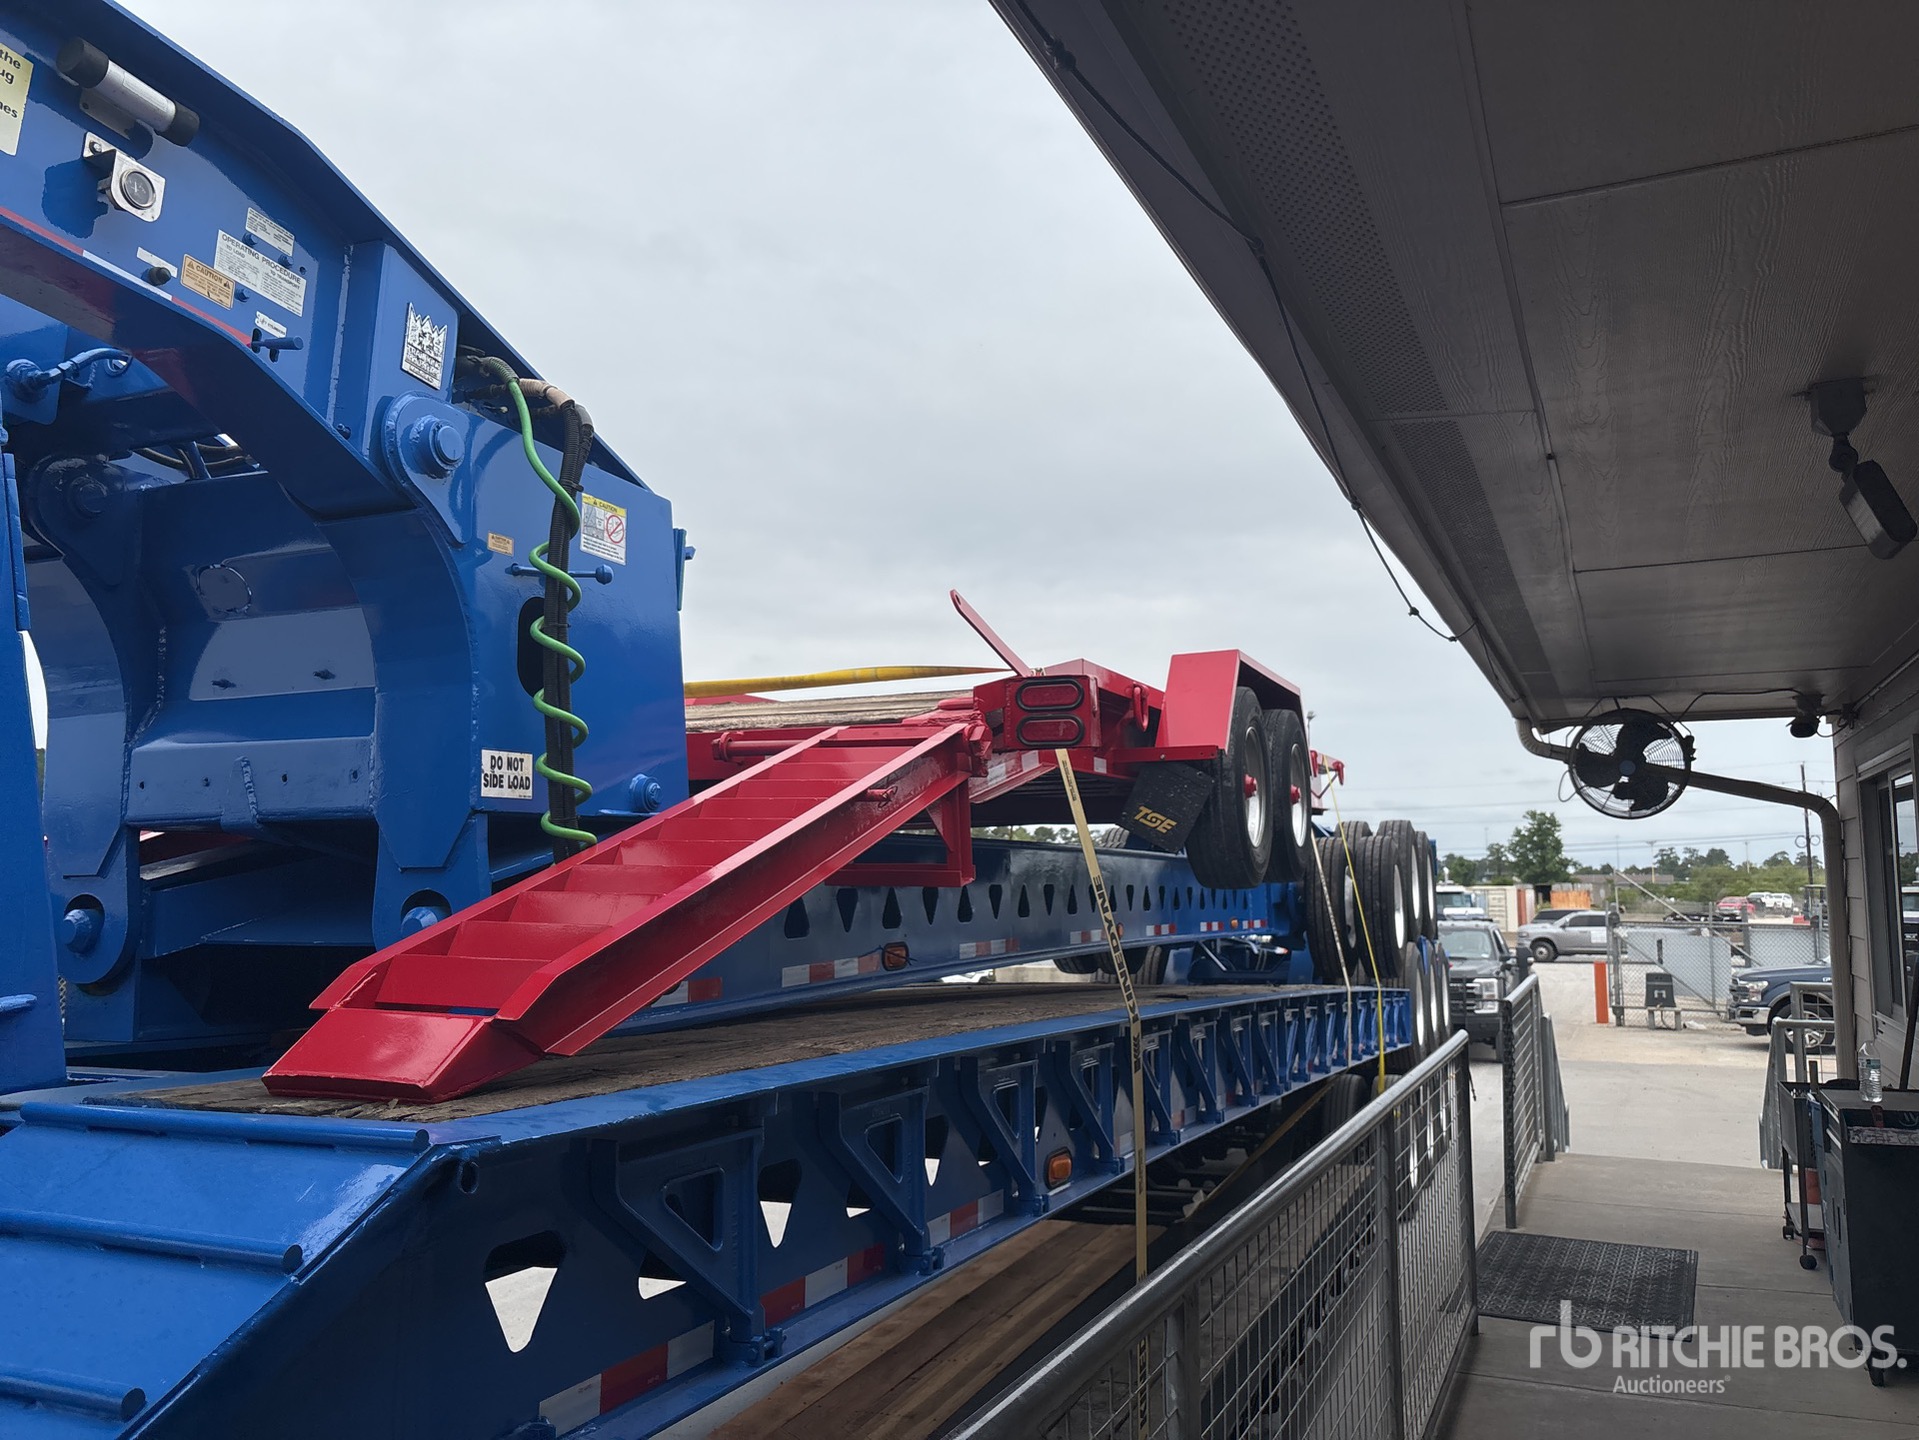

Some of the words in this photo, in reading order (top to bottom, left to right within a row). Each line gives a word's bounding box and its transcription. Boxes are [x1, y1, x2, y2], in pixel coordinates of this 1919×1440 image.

[222, 234, 260, 261] OPERATING
[262, 256, 301, 285] PROCEDURE
[196, 265, 223, 284] CAUTION
[599, 501, 618, 513] CAUTION
[491, 755, 503, 771] DO
[507, 756, 524, 771] NOT
[483, 773, 504, 788] SIDE
[507, 775, 530, 790] LOAD
[1093, 875, 1139, 1024] KINEDYNE
